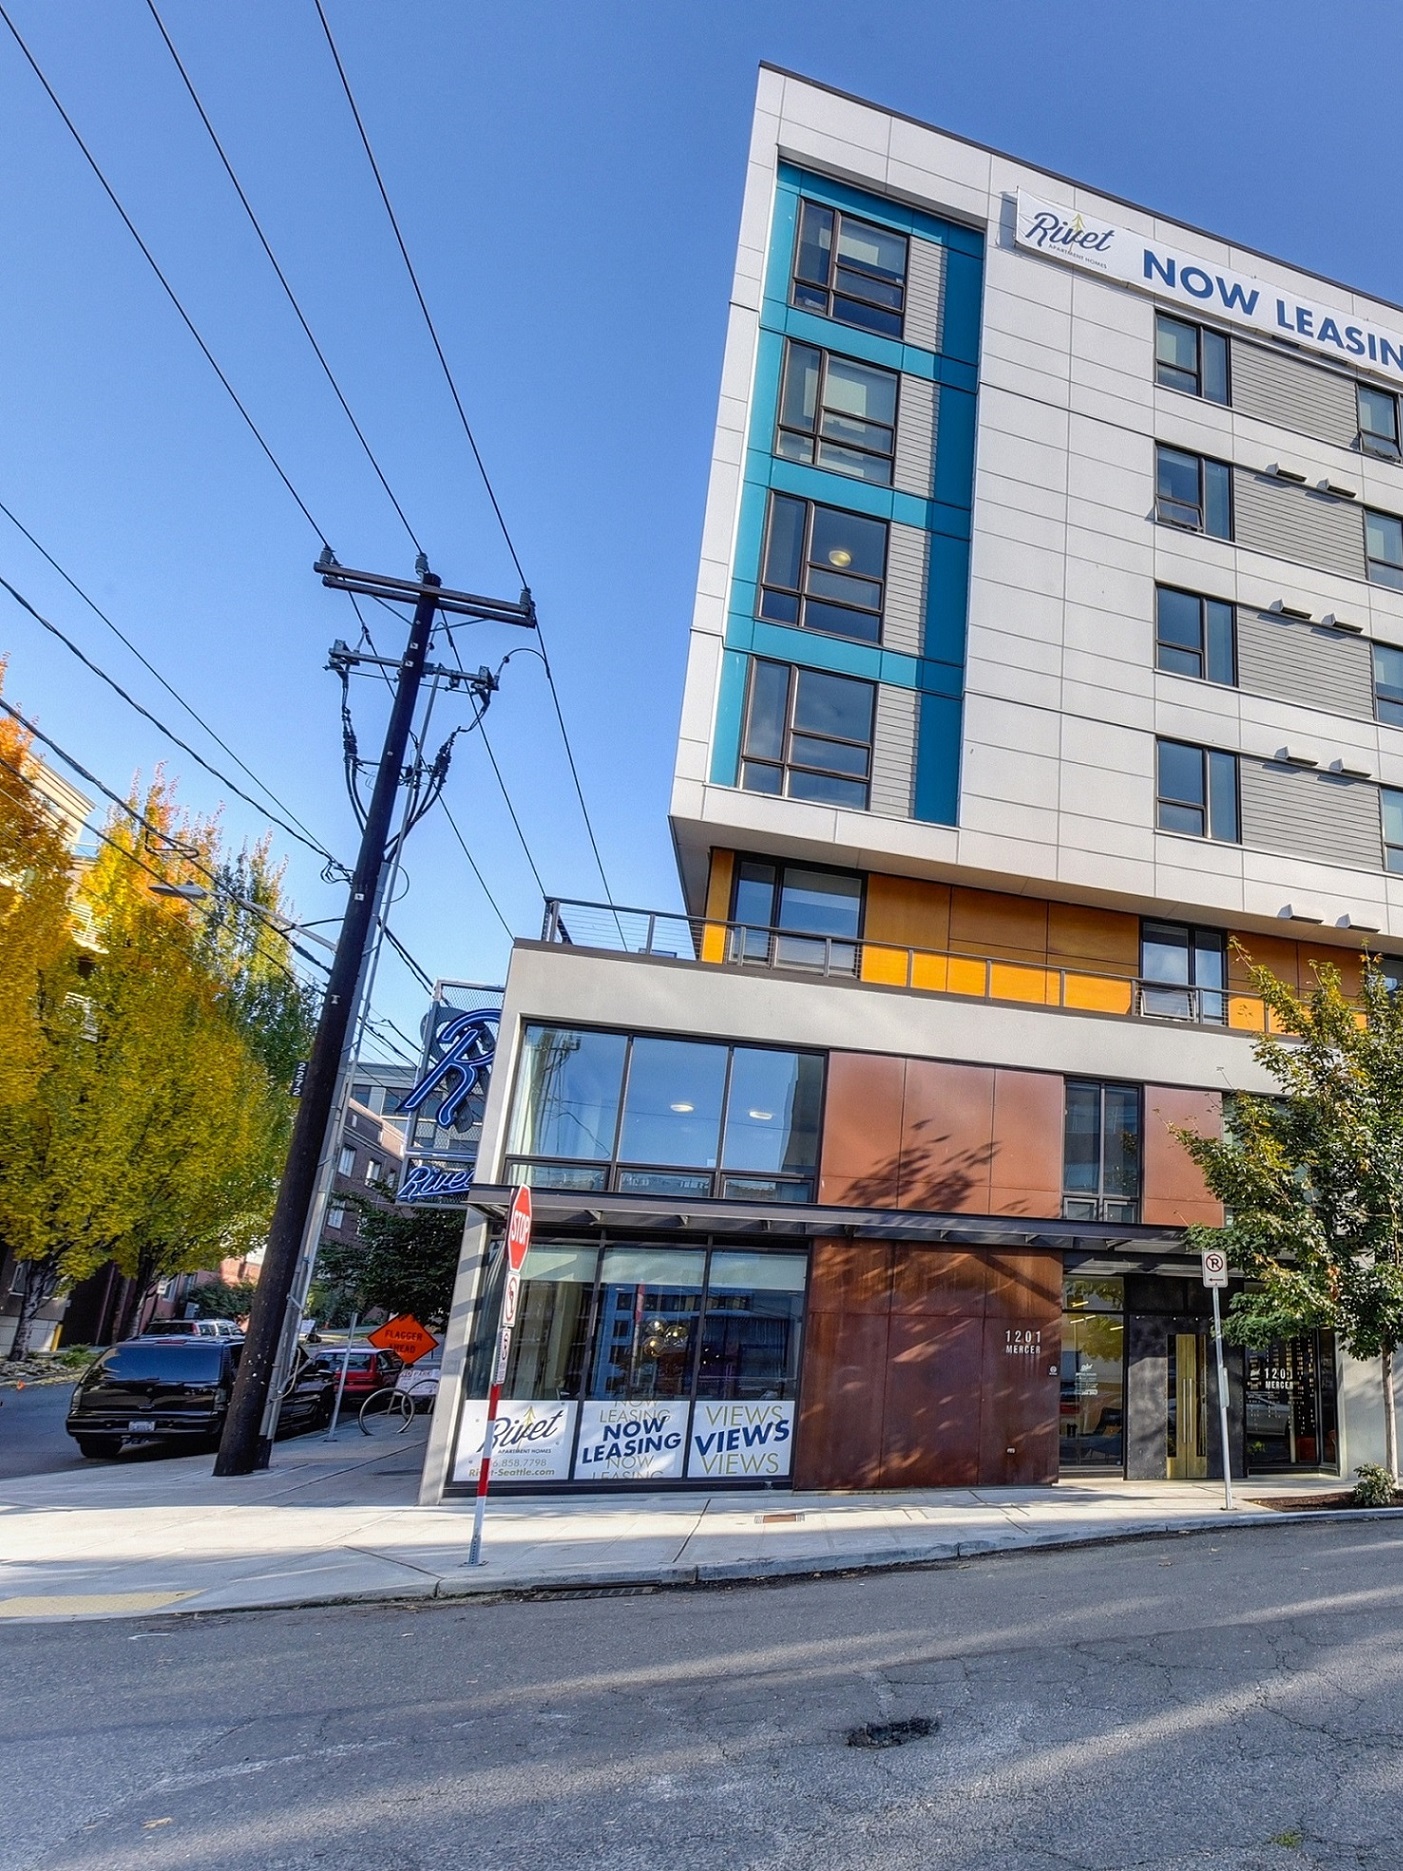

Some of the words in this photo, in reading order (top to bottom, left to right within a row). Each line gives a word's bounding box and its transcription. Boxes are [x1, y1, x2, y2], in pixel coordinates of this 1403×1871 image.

[1026, 212, 1115, 252] Rivet
[1048, 244, 1084, 260] APARTMENT
[1085, 257, 1107, 269] HOMES
[1143, 249, 1260, 316] NOW
[293, 1062, 306, 1096] 2272
[511, 1209, 530, 1245] STOP
[384, 1330, 423, 1341] FLAGGER
[1005, 1330, 1041, 1342] 1201
[389, 1343, 416, 1353] AHEAD
[1005, 1345, 1041, 1354] MERCER
[600, 1409, 671, 1423] LEASING
[706, 1405, 783, 1426] VIEWS
[476, 1410, 564, 1453] Rivet
[603, 1415, 668, 1441] NOW
[694, 1419, 790, 1457] VIEWS
[582, 1432, 682, 1464] LEASING
[468, 1468, 555, 1477] Rit-Seattle.com
[492, 1458, 547, 1467] 6.858.7798
[606, 1455, 654, 1469] NOW
[702, 1452, 779, 1475] VIEWS
